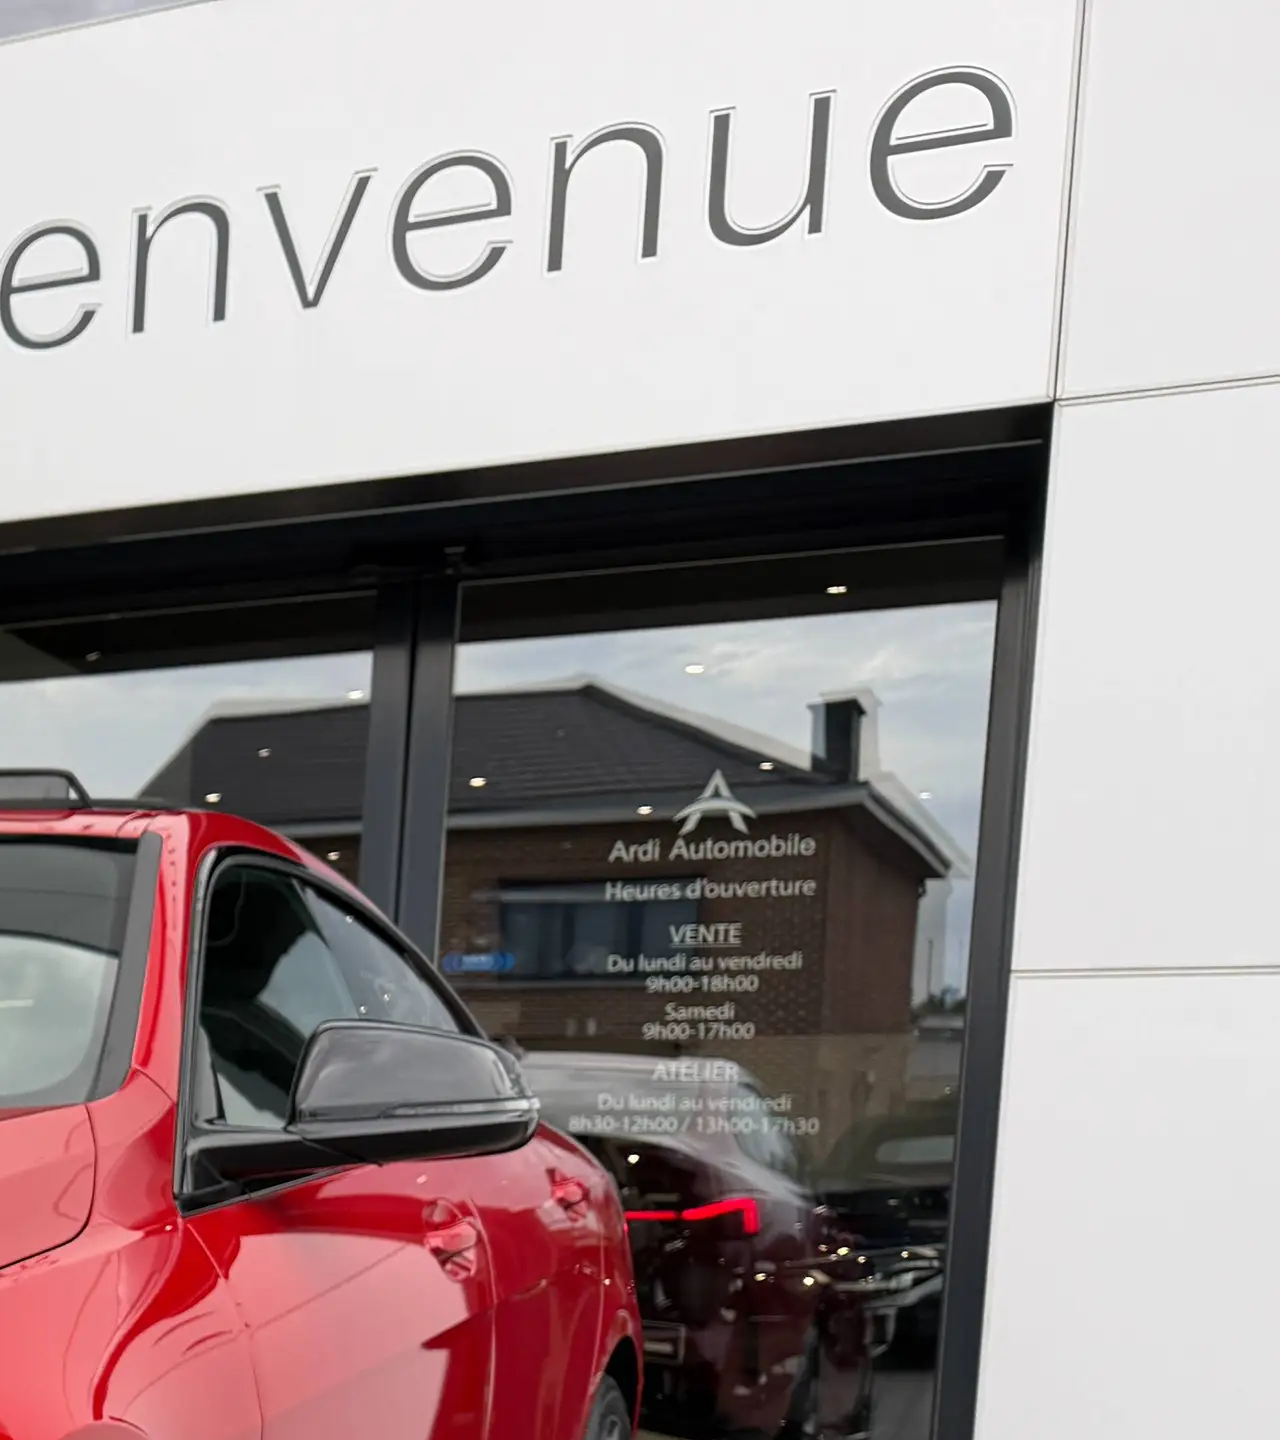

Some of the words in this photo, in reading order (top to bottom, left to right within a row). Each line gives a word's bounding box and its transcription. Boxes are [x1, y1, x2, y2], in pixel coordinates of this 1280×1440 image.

[607, 838, 661, 864] Ardi
[668, 832, 817, 861] Automobile
[604, 879, 682, 902] Heures
[684, 876, 817, 901] d'ouverture
[669, 922, 743, 946] VENTE
[607, 953, 635, 973] Du
[637, 952, 687, 972] lundi
[689, 955, 715, 971] au
[717, 950, 804, 971] vendredi
[645, 974, 759, 994] 9h00-18h00
[664, 1001, 736, 1021] Samedi
[642, 1021, 756, 1041] 9h00-17h00
[651, 1061, 740, 1083] ATELIER
[597, 1092, 625, 1112] Du
[628, 1092, 677, 1112] lundi
[680, 1096, 705, 1112] au
[708, 1092, 793, 1112] vendredi
